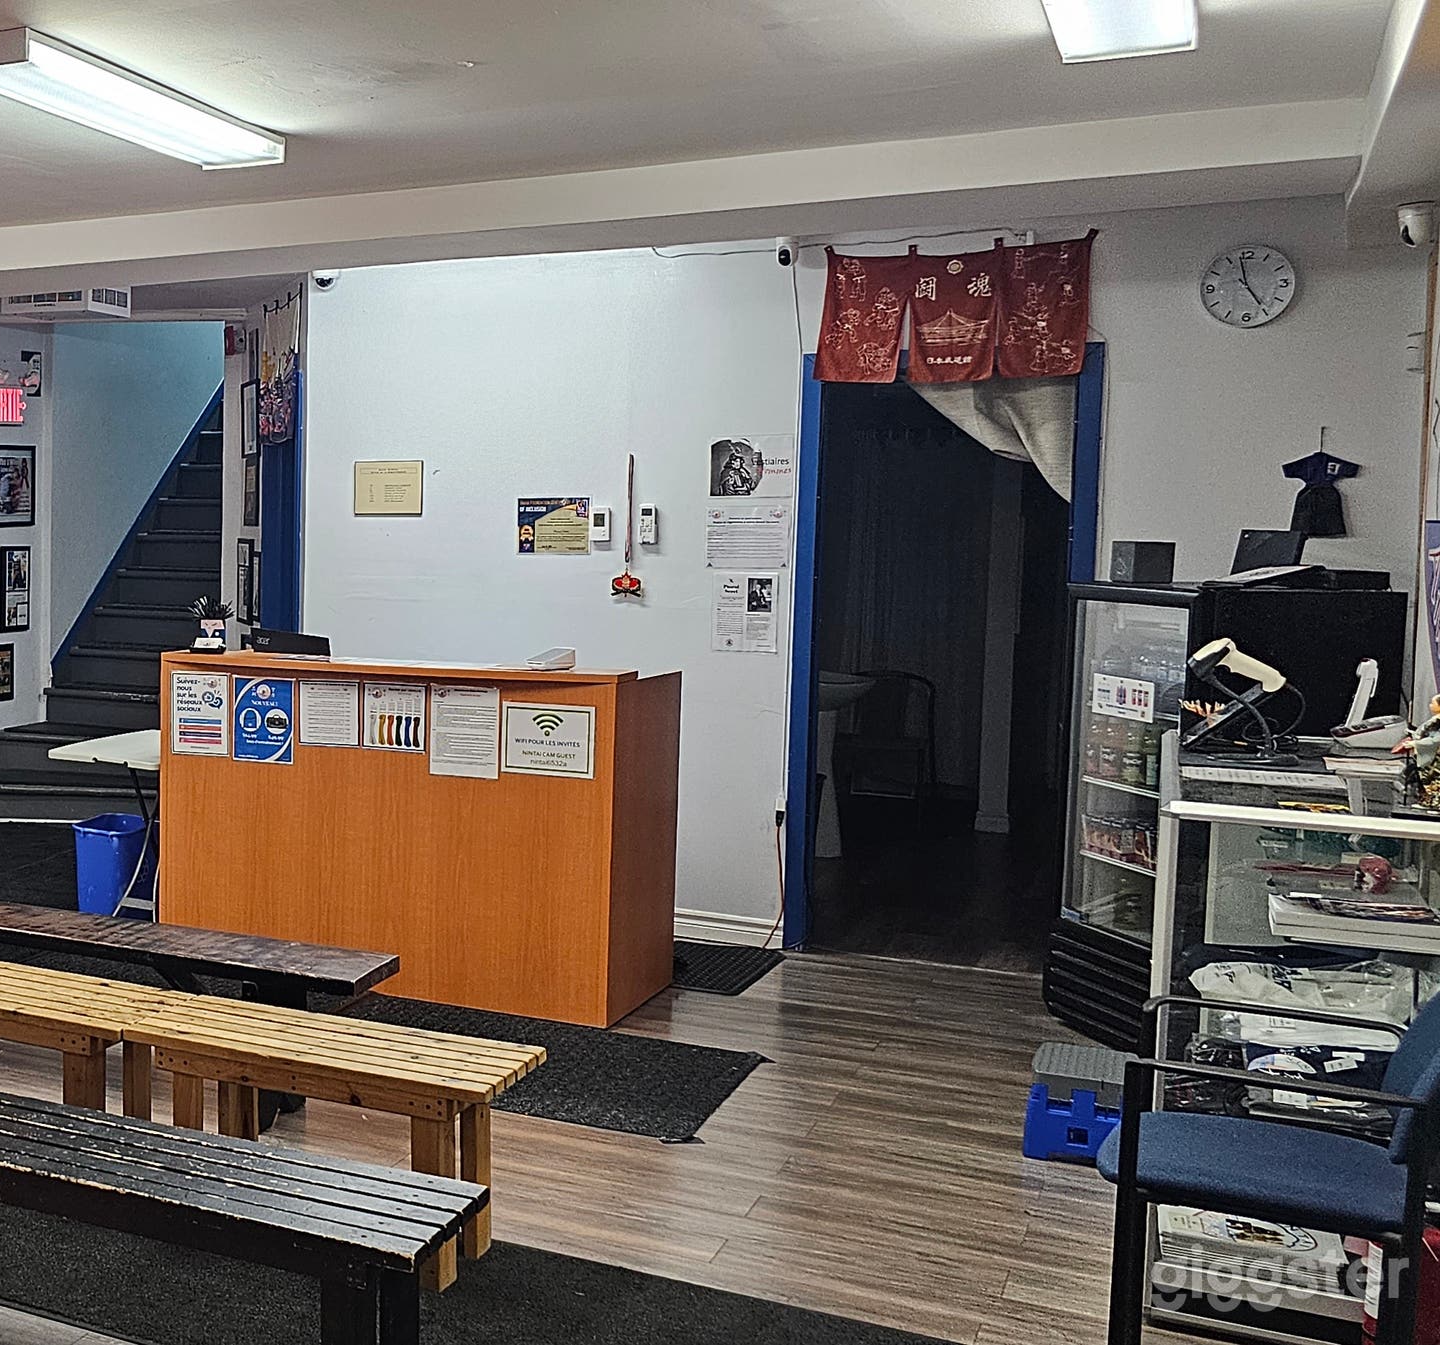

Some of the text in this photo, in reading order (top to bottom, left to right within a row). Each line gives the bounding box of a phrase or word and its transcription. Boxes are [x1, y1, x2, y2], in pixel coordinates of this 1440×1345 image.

[1242, 250, 1257, 260] 12
[1279, 278, 1289, 288] 3
[1206, 284, 1216, 294] 9
[1241, 312, 1252, 322] 6
[256, 636, 271, 645] acer
[176, 676, 201, 685] Suivez-
[188, 691, 197, 699] les
[176, 705, 202, 713] sociaux
